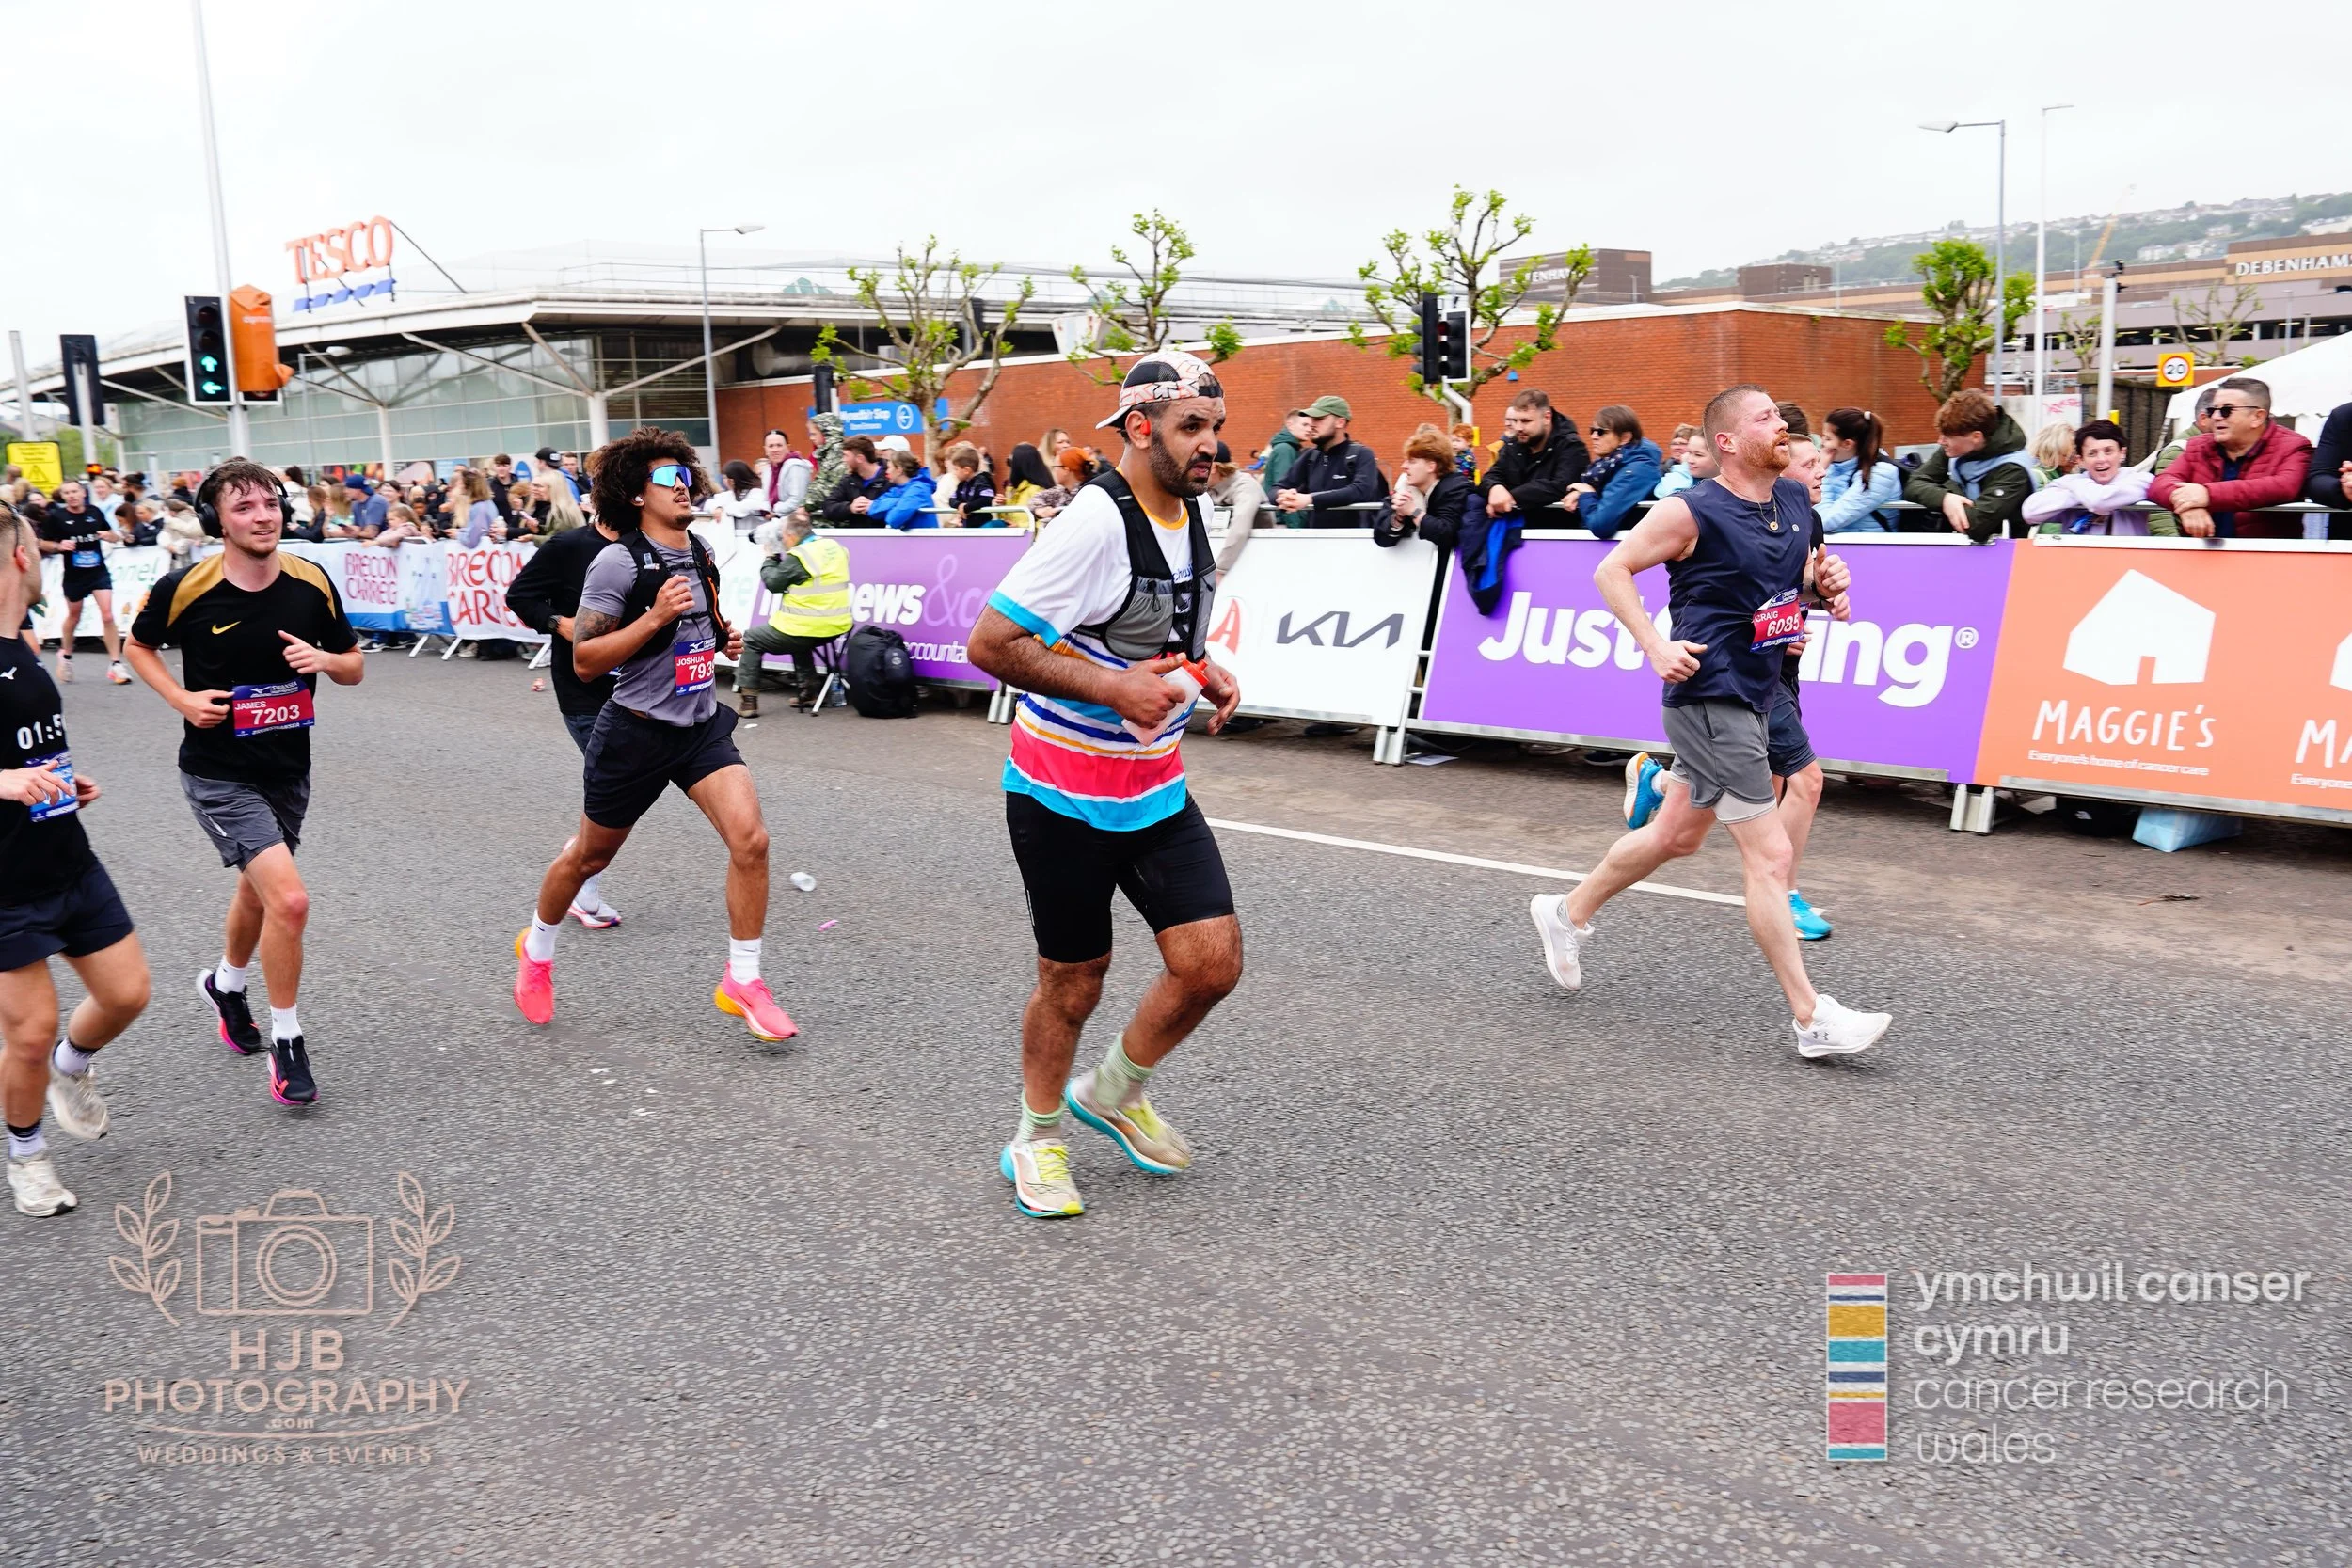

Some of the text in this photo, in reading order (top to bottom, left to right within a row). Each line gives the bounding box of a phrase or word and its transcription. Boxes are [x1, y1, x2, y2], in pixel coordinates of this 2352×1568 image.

[285, 215, 392, 284] TESCO
[2236, 255, 2352, 276] DEBENHAM
[2167, 364, 2185, 374] 20
[345, 552, 398, 578] BRECON
[345, 577, 397, 605] CARREG
[1755, 610, 1779, 623] CRAIG
[1767, 613, 1800, 637] 6085
[1276, 610, 1405, 649] KIA
[676, 656, 705, 667] JOSHUA
[235, 700, 267, 710] JAMES
[251, 704, 300, 725] 7203
[2031, 699, 2217, 752] MAGGIE'S
[2028, 749, 2210, 776] Everyone's home of cancer care
